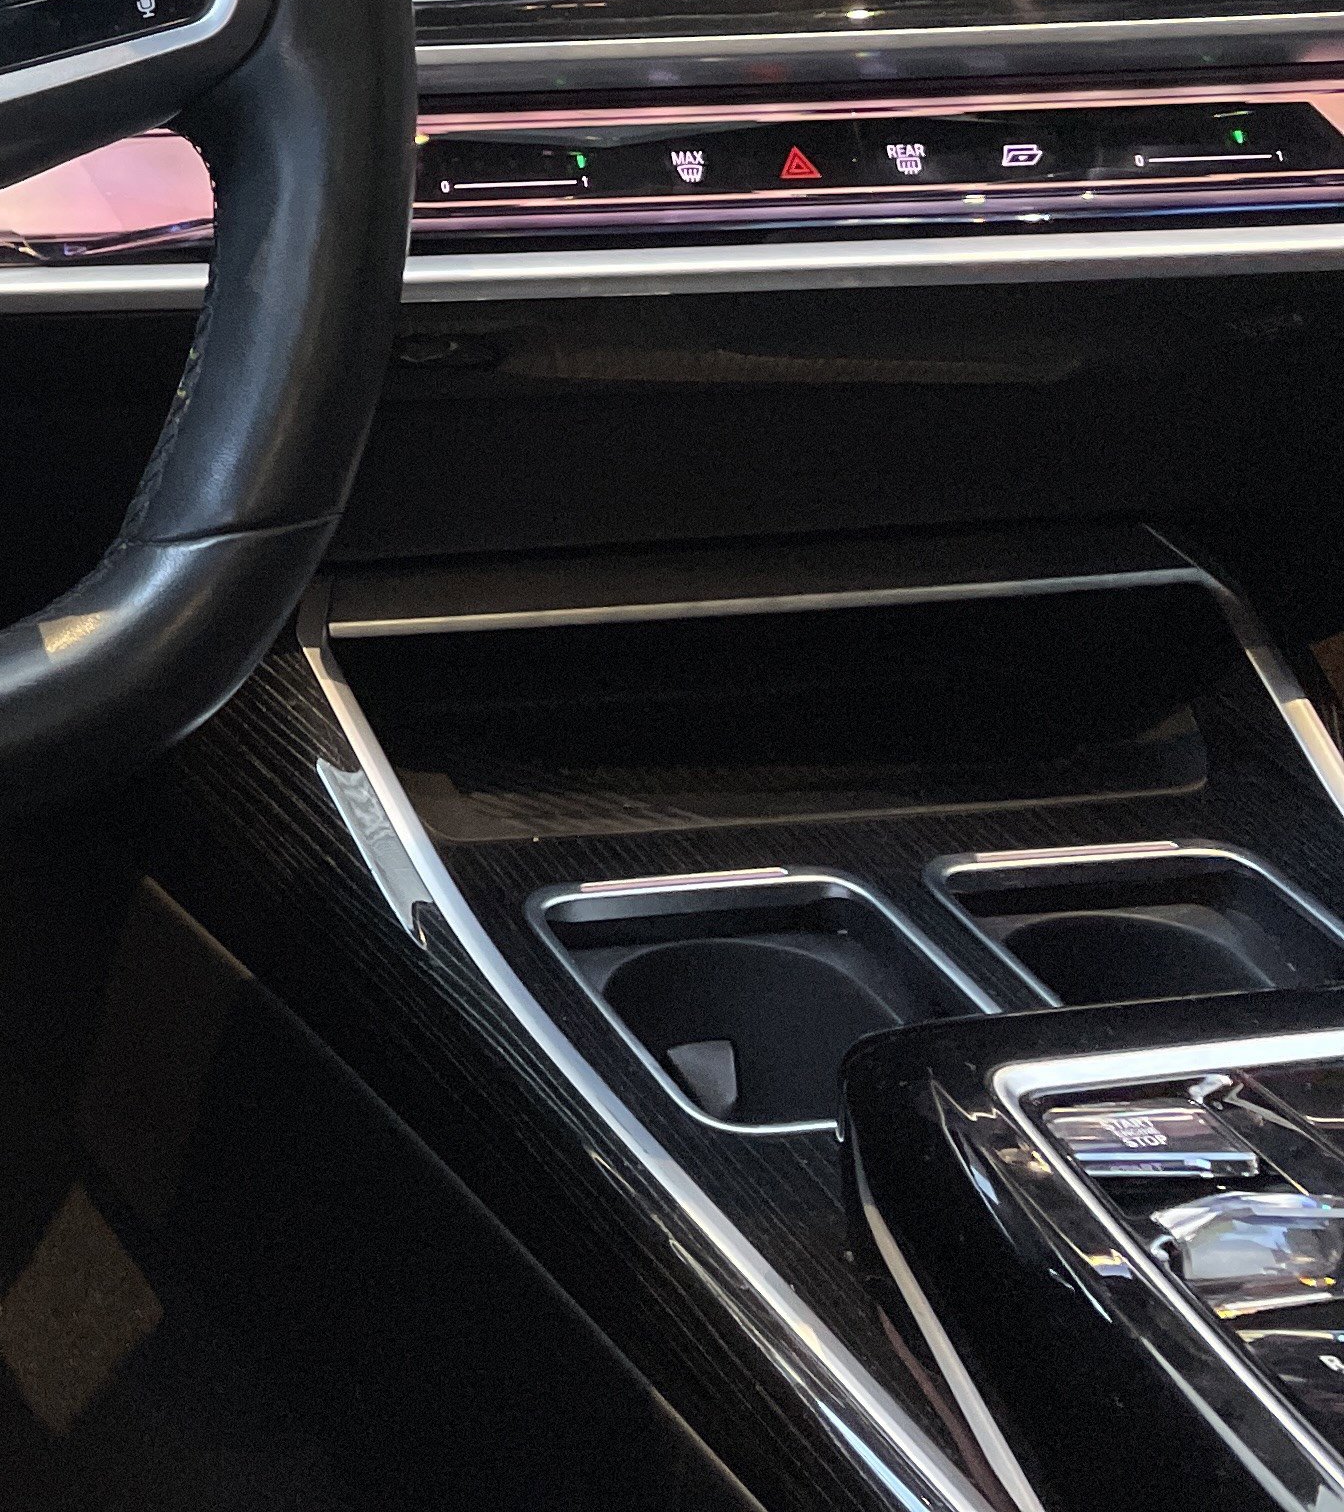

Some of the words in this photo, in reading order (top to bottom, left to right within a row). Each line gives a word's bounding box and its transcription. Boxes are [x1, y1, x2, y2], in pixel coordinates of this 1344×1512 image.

[671, 150, 704, 165] MAX
[886, 143, 926, 159] REAR
[1276, 150, 1284, 162] 1
[1134, 154, 1144, 167] 0
[440, 180, 450, 193] 0
[581, 175, 589, 188] 1
[1122, 1134, 1168, 1148] STOP
